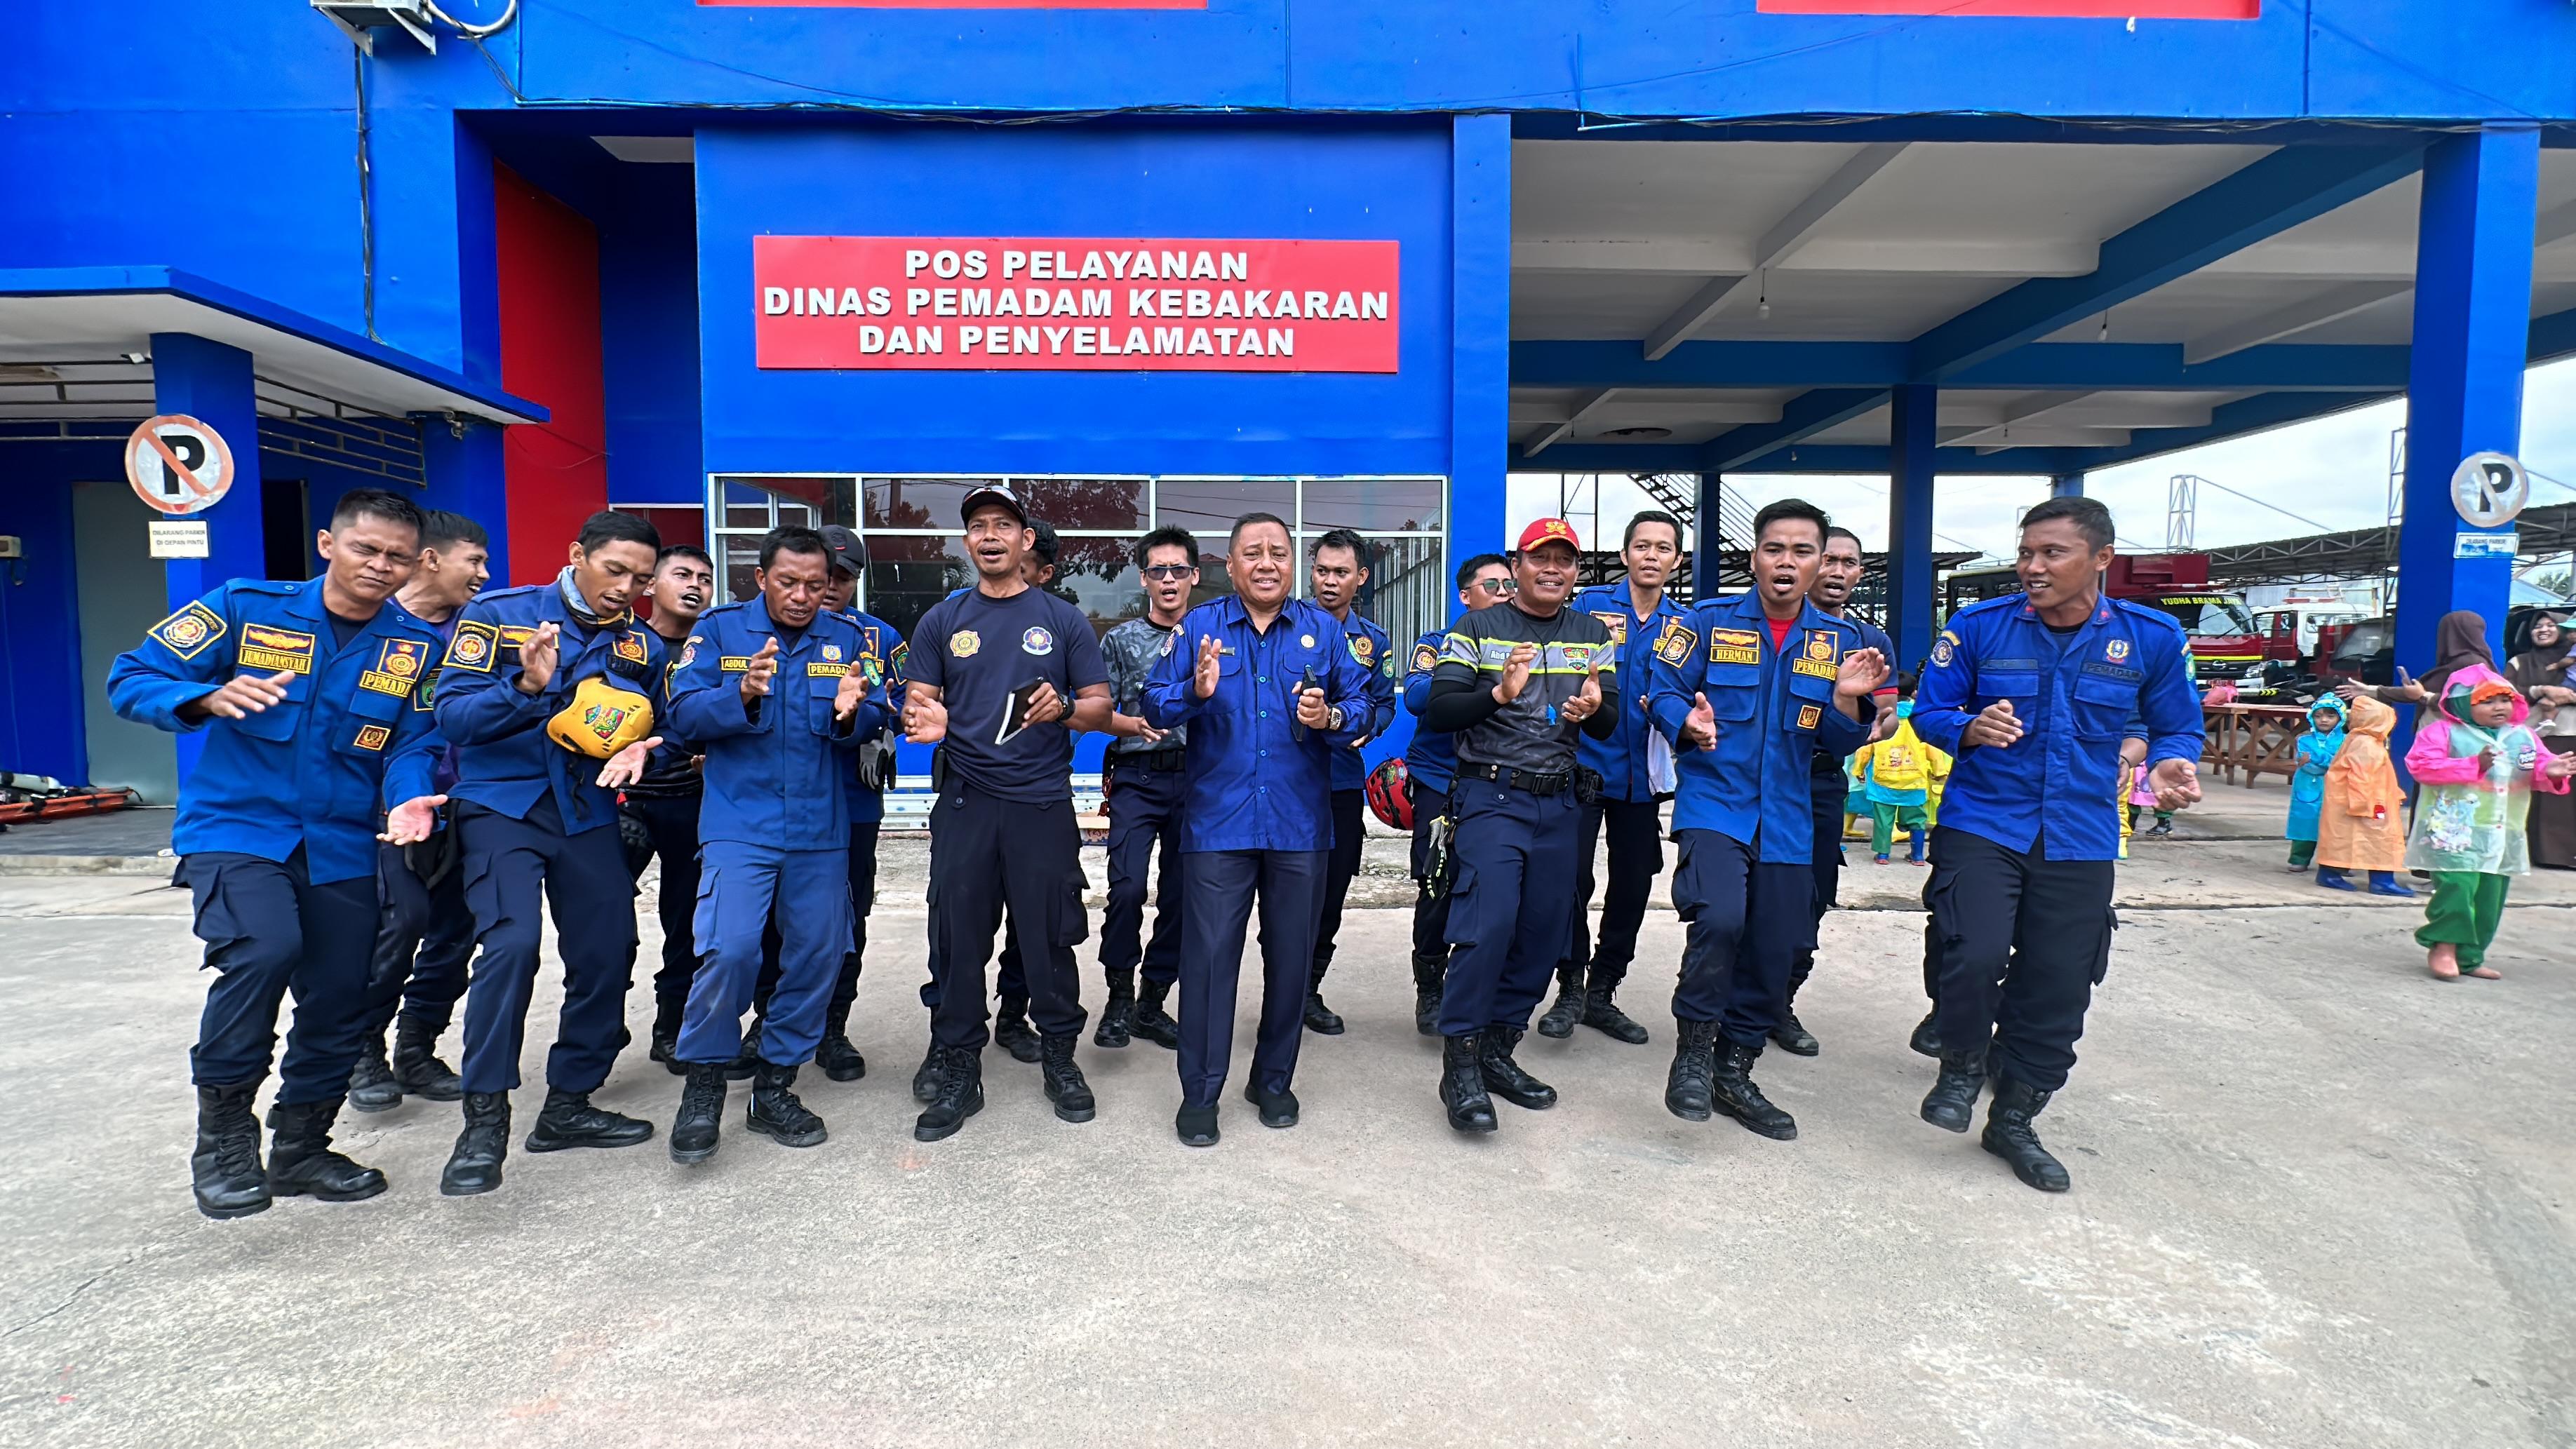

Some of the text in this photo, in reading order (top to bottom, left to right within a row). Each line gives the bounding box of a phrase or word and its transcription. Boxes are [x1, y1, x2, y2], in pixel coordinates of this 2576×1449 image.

[906, 250, 1247, 281] POS PELAYANAN
[764, 286, 1388, 319] DINAS PEMADAM KEBAKARAN
[859, 325, 1294, 356] DAN PENYELAMATAN
[160, 435, 206, 495] P
[2481, 463, 2514, 512] P
[724, 659, 748, 668] ABDUL
[810, 664, 850, 675] PEMADA
[1490, 649, 1505, 660] Abd
[1716, 649, 1753, 662] HERMAN
